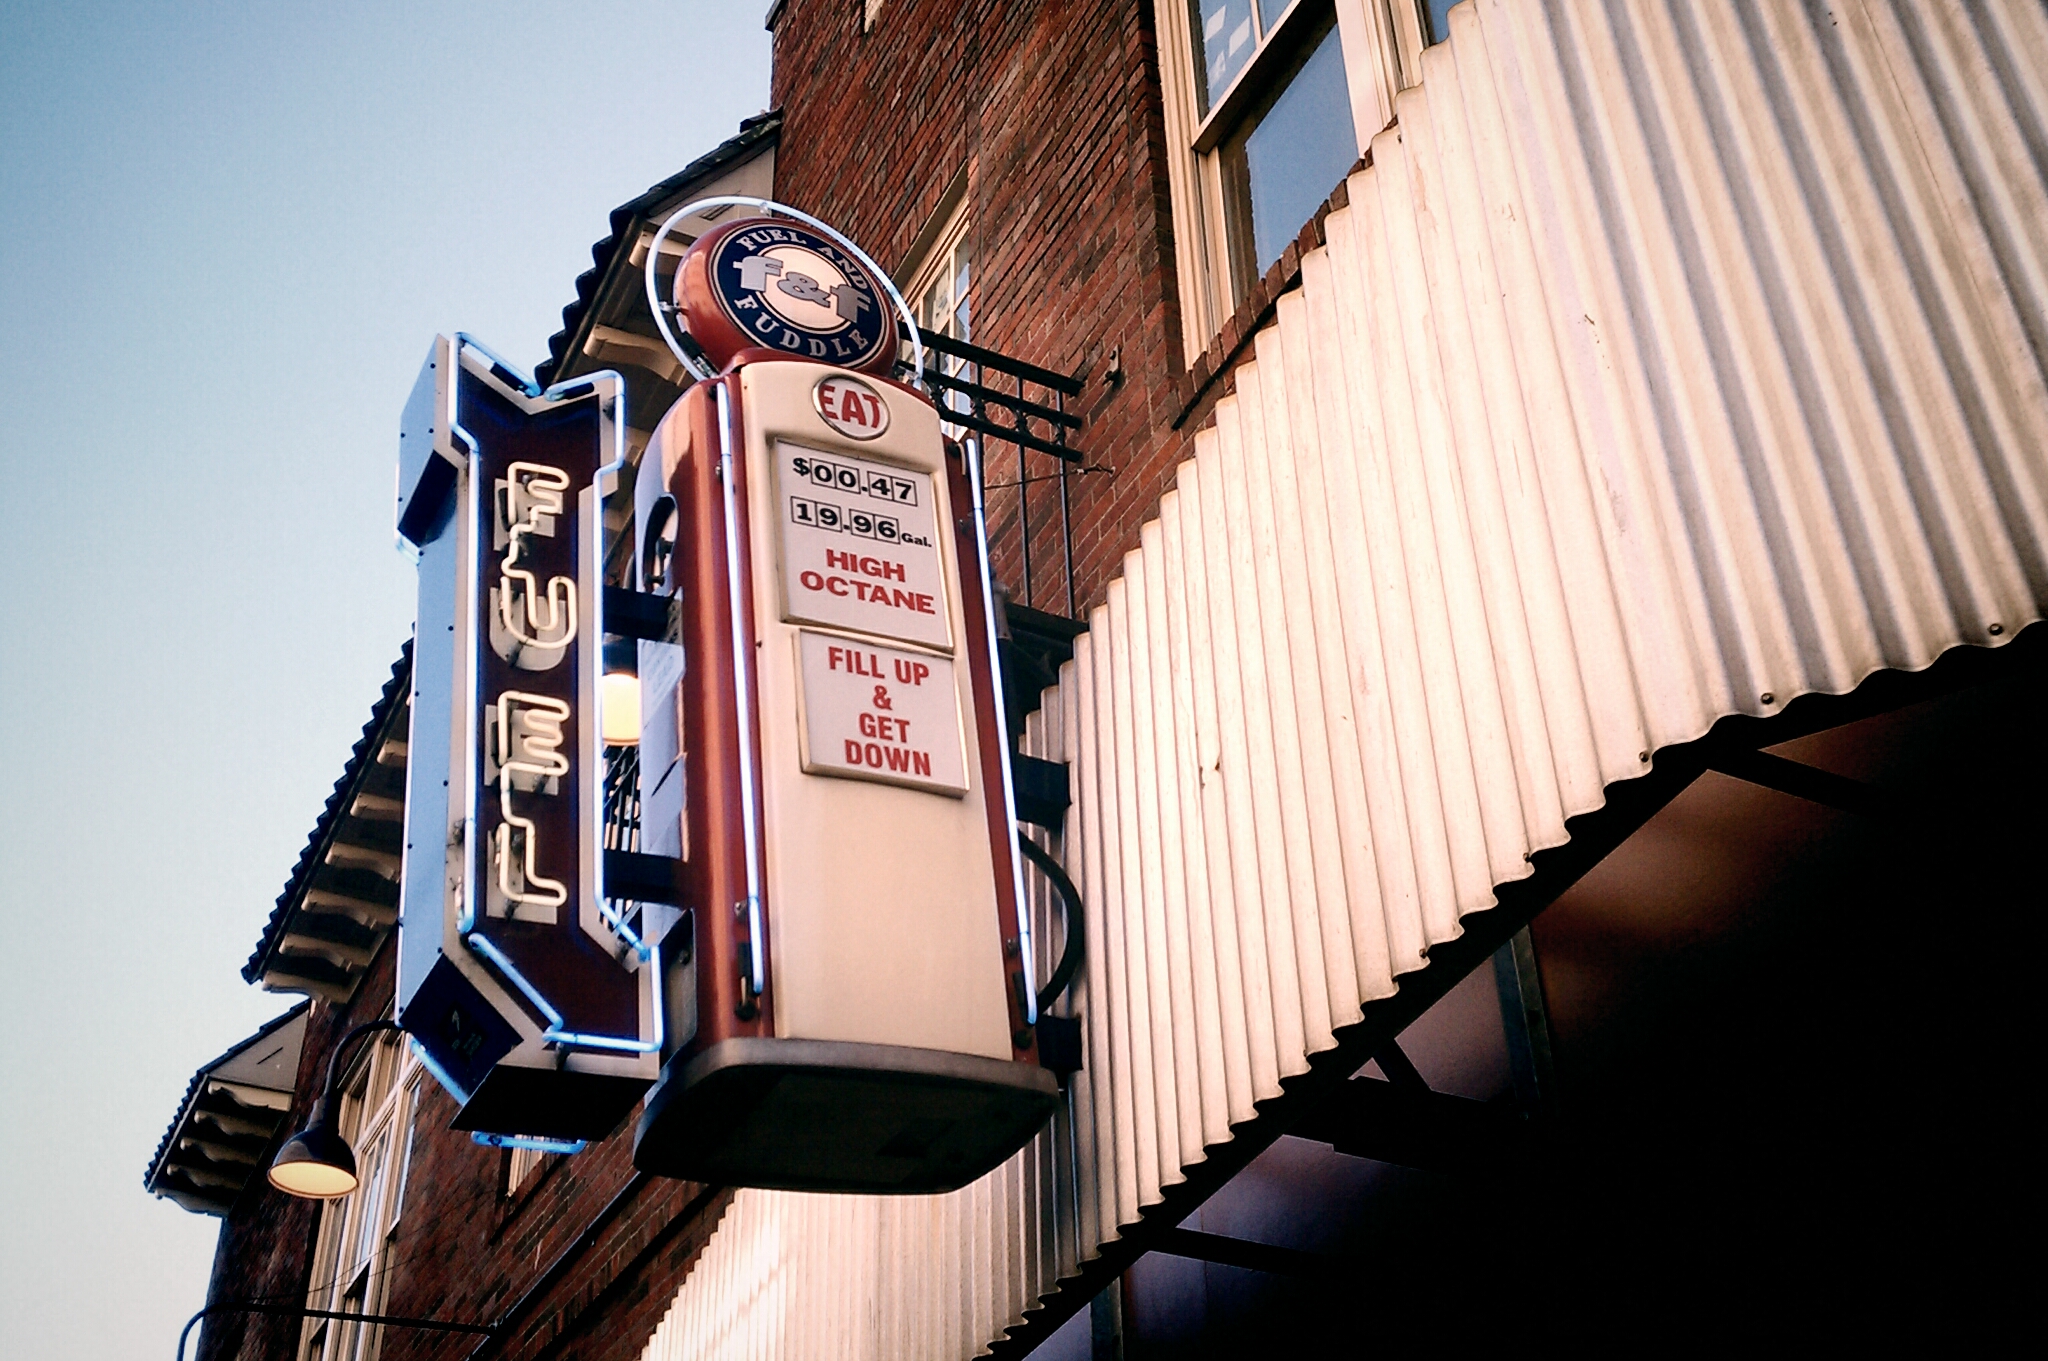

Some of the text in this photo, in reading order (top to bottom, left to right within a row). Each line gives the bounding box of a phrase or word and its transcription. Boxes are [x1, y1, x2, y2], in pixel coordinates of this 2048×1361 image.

[736, 228, 868, 290] FUEL AND
[734, 295, 868, 357] FUDDLE
[820, 384, 881, 429] EAT
[793, 457, 912, 500] $00.47
[826, 549, 906, 583] HIGH
[800, 570, 936, 615] OCTANE
[828, 646, 930, 686] FILL UP
[485, 461, 577, 925] FUEL
[872, 684, 893, 711] &
[858, 712, 910, 743] GET
[844, 739, 931, 777] DOWN
